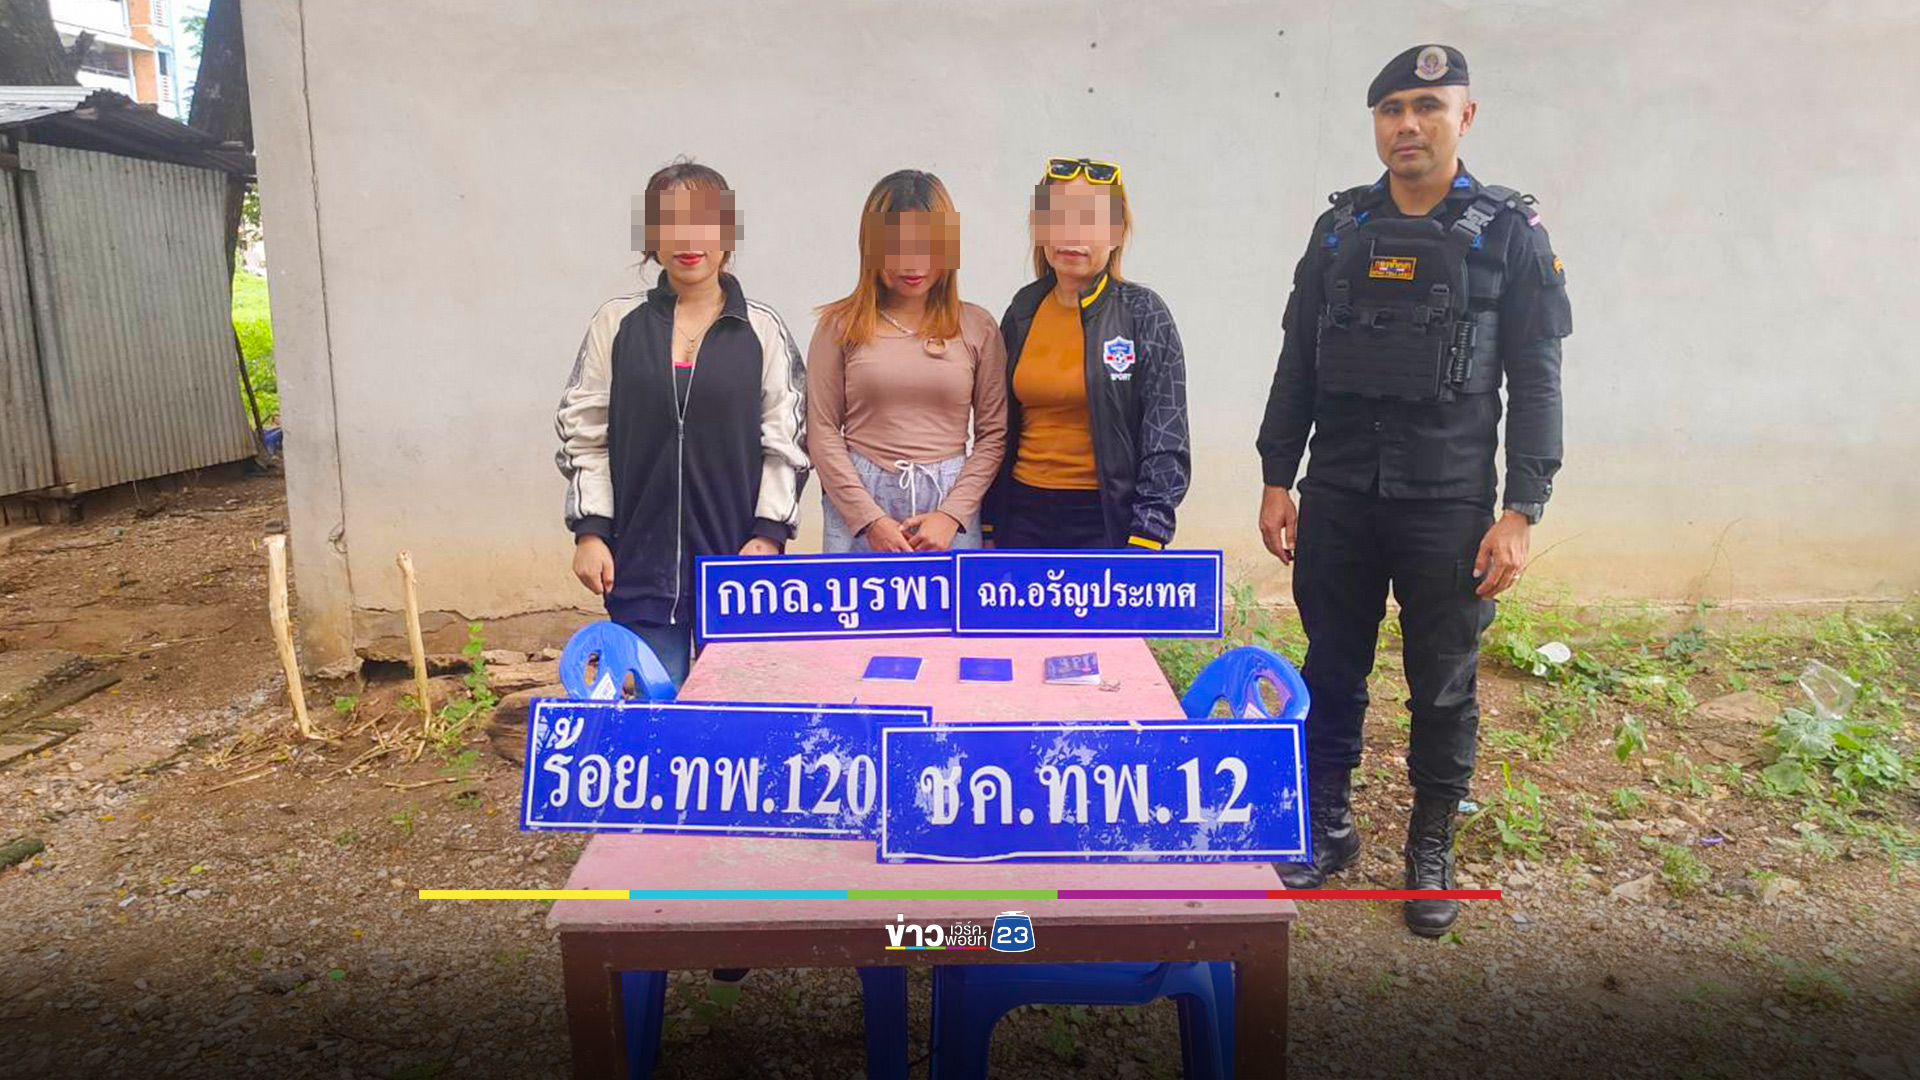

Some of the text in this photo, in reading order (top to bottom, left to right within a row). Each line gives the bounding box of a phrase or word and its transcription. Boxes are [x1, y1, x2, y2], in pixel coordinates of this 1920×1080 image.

[718, 575, 950, 629] กกล.บูรพา
[977, 568, 1197, 618] ฉก.อรัญประเทศ
[543, 716, 877, 817] ร้อย.ทพ.120
[920, 756, 1252, 826] ชค.ทพ.12
